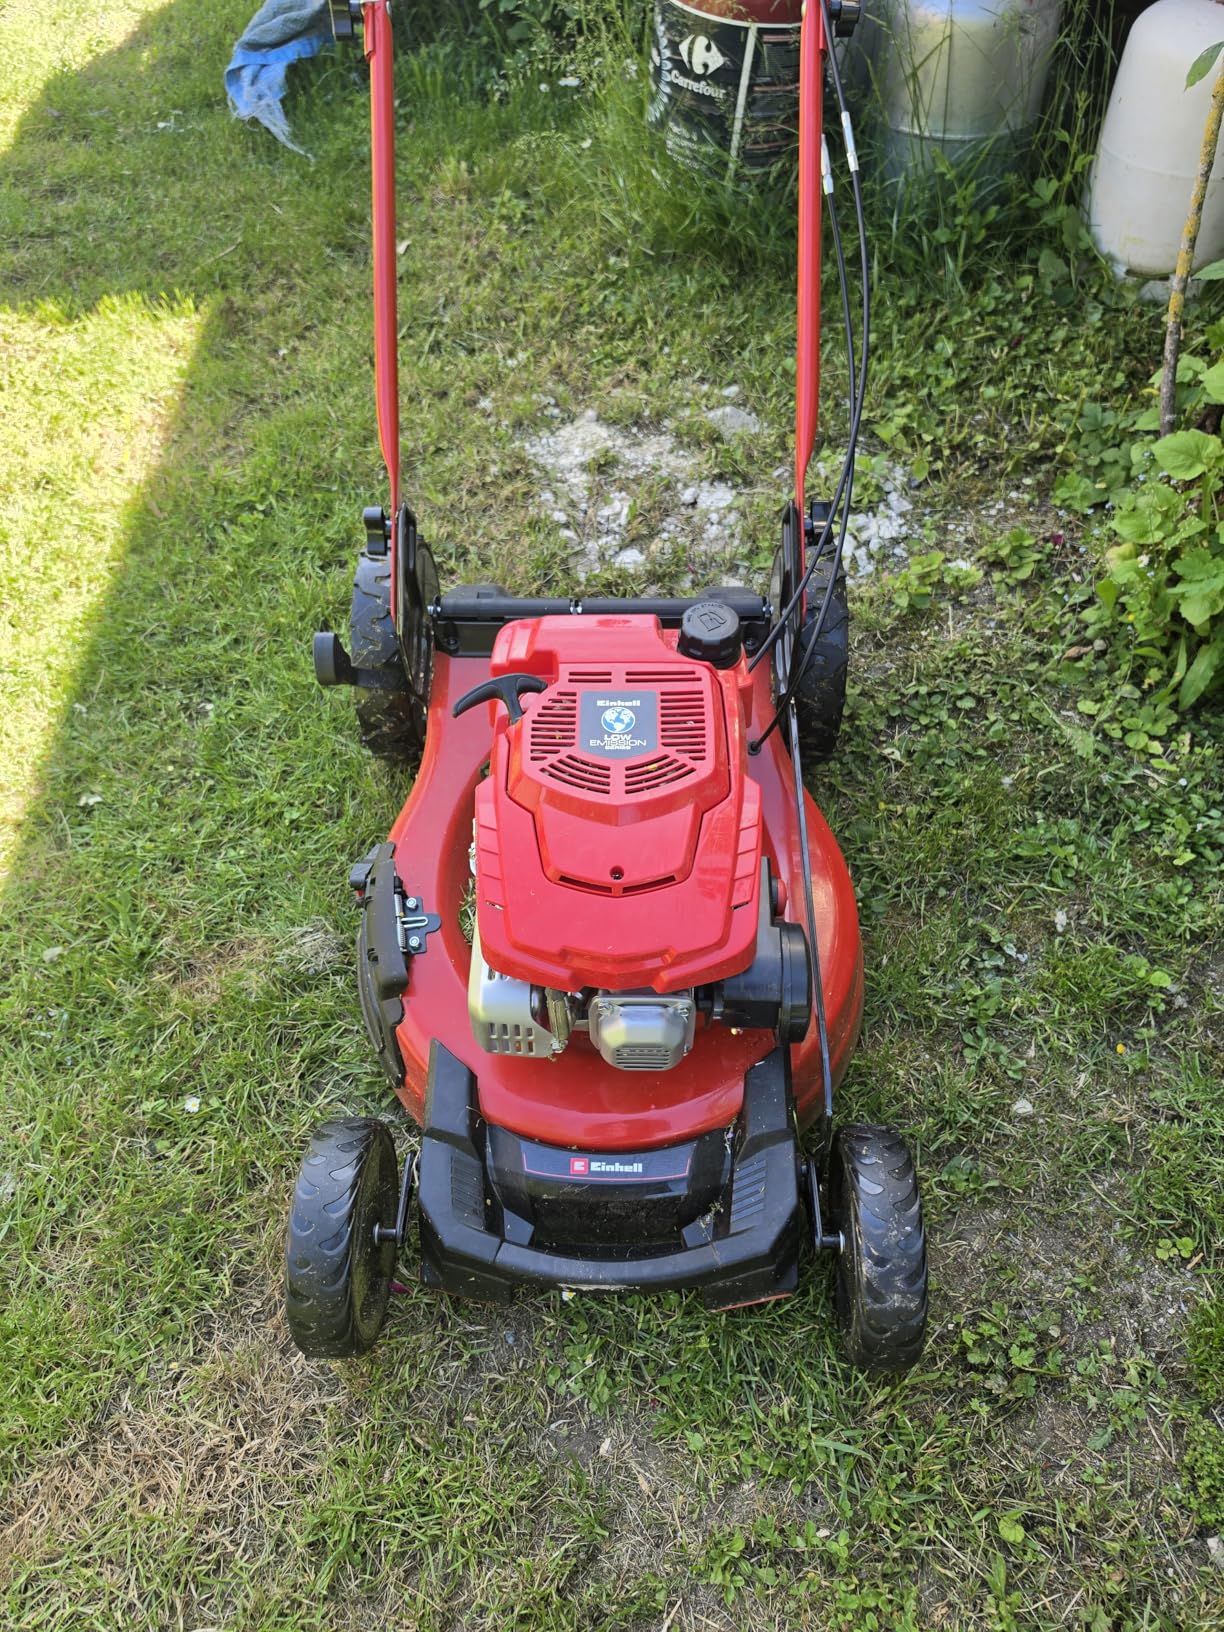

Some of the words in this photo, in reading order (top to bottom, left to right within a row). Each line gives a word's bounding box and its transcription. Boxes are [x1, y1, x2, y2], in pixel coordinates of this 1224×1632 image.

[671, 70, 726, 99] Carrefour
[590, 739, 647, 747] EMISSION
[590, 1161, 643, 1173] Einhell
